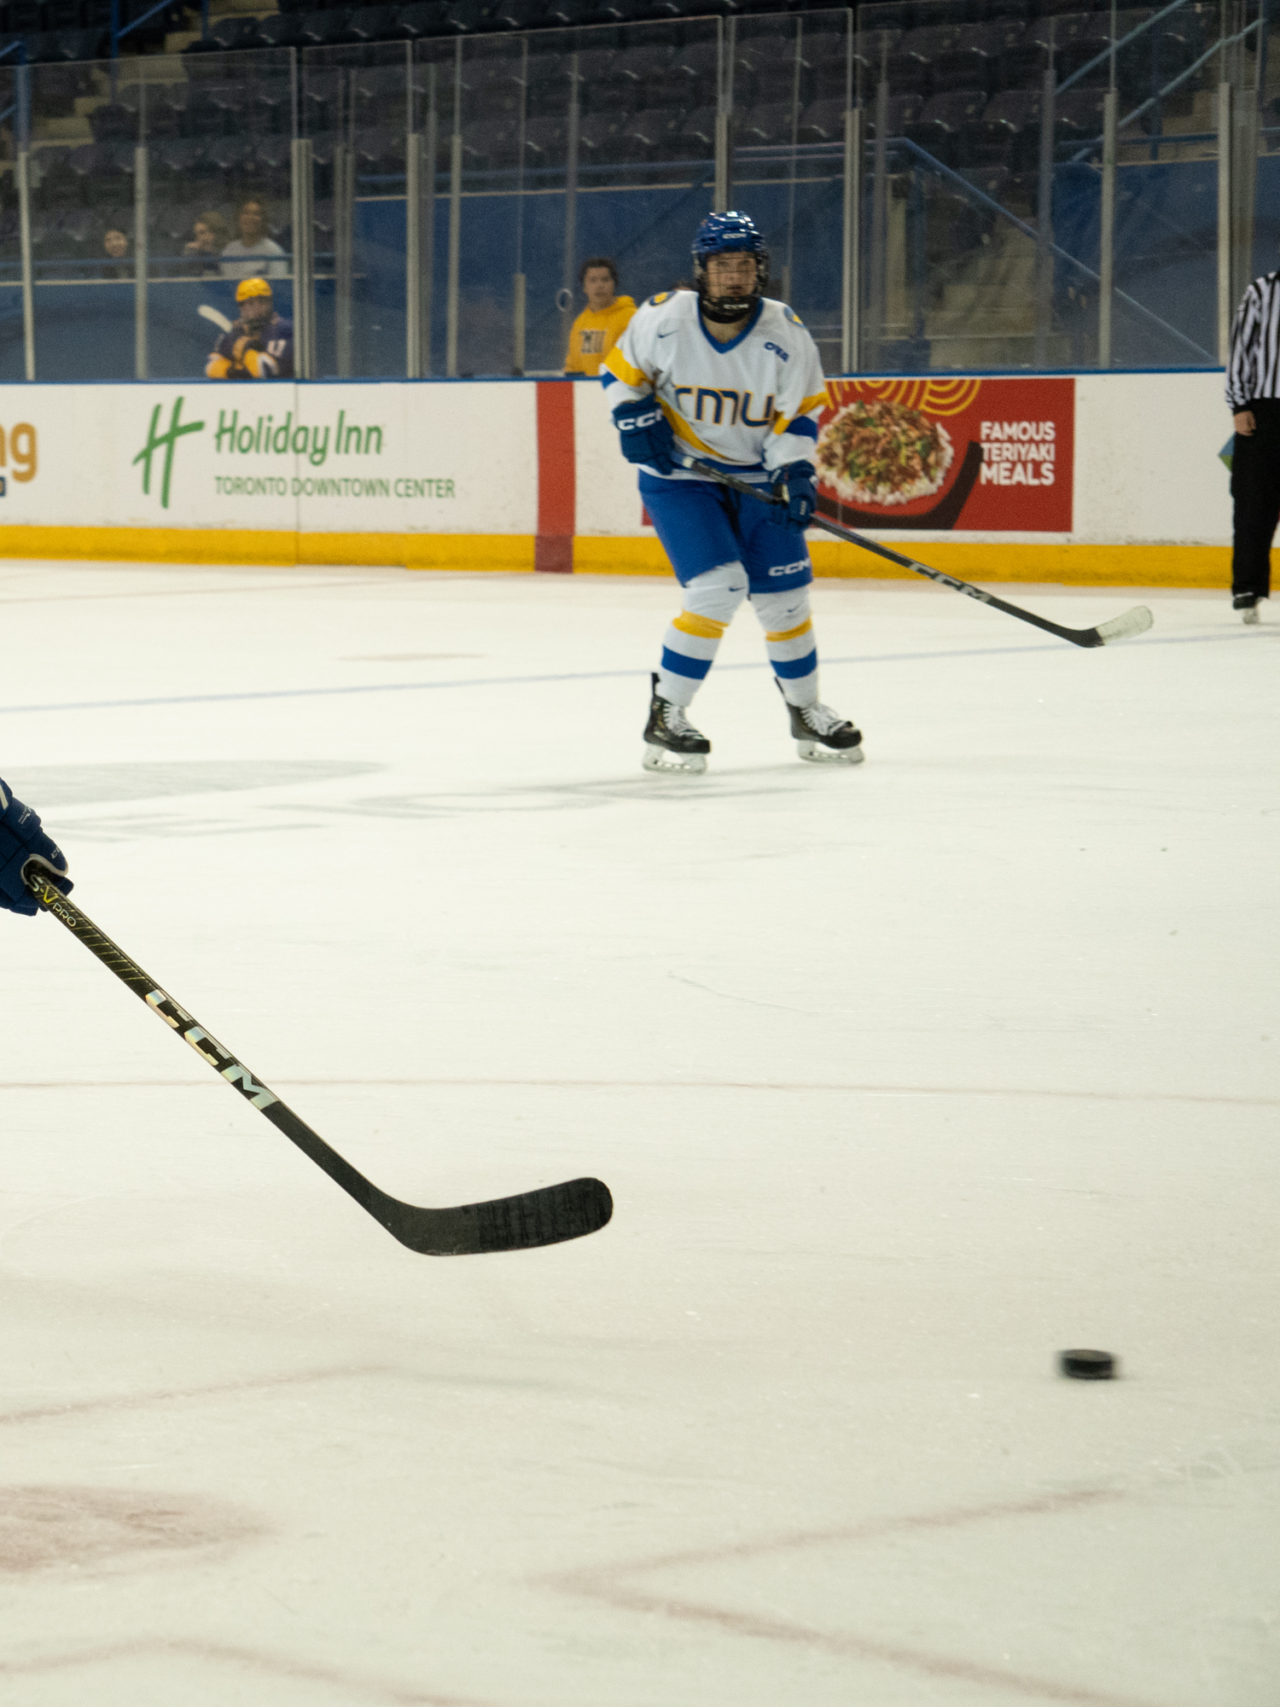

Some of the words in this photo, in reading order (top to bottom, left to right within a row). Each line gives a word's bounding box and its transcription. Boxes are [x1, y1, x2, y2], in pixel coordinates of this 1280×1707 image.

[214, 409, 330, 466] Holiday
[335, 409, 383, 454] Inn
[980, 421, 1056, 441] FAMOUS
[981, 442, 1056, 462] TERIYAKI
[980, 462, 1056, 486] MEALS
[214, 476, 287, 497] TORONTO
[291, 477, 390, 498] DOWNTOWN
[394, 478, 456, 499] CENTER
[768, 558, 811, 576] CCM
[52, 902, 77, 927] PRO
[145, 988, 281, 1111] CCM
